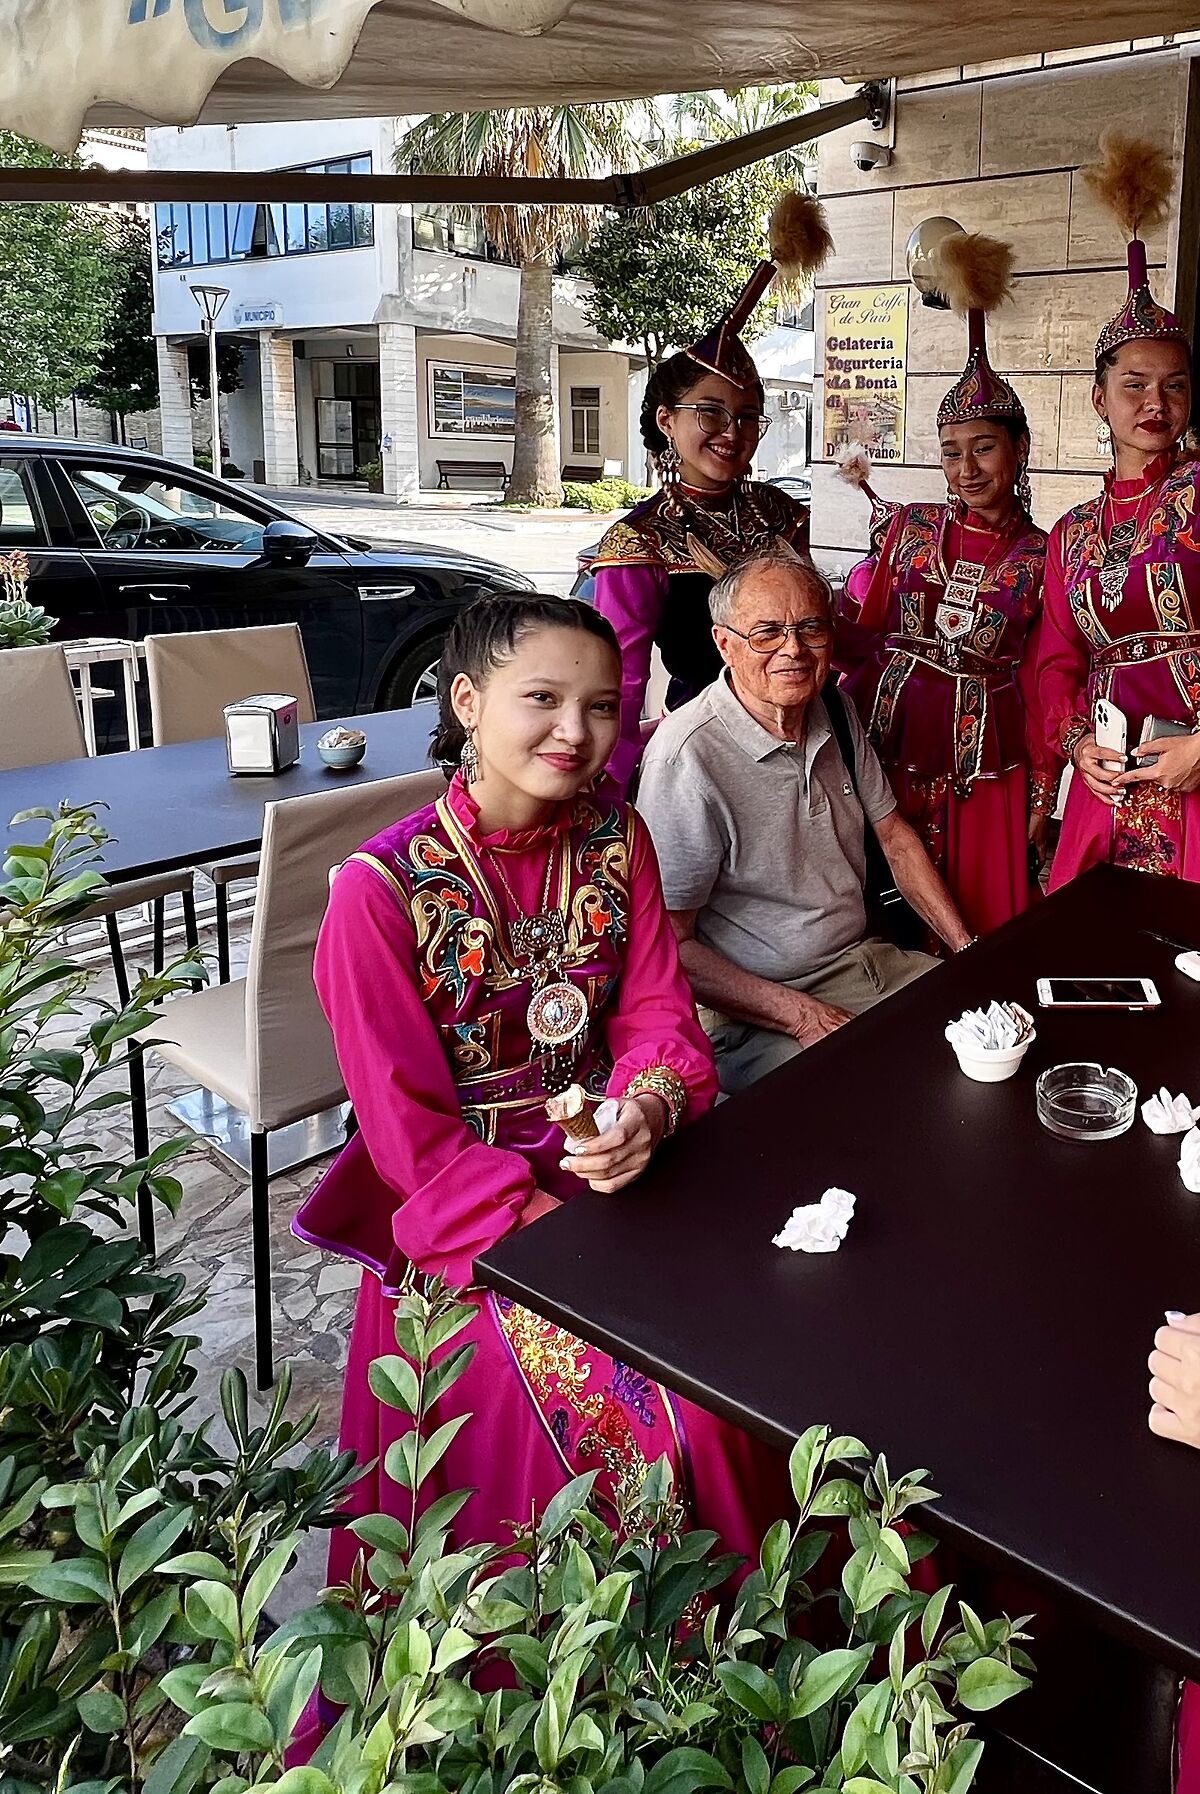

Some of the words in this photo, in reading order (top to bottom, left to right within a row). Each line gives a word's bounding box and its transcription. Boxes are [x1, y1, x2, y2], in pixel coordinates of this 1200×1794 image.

[828, 294, 861, 315] Gran
[244, 310, 276, 322] MUNICIPIO
[839, 311, 854, 325] de
[856, 309, 892, 325] Paris
[826, 336, 894, 351] Gelateria
[826, 356, 903, 373] Yogurteria
[855, 375, 898, 390] Bontà
